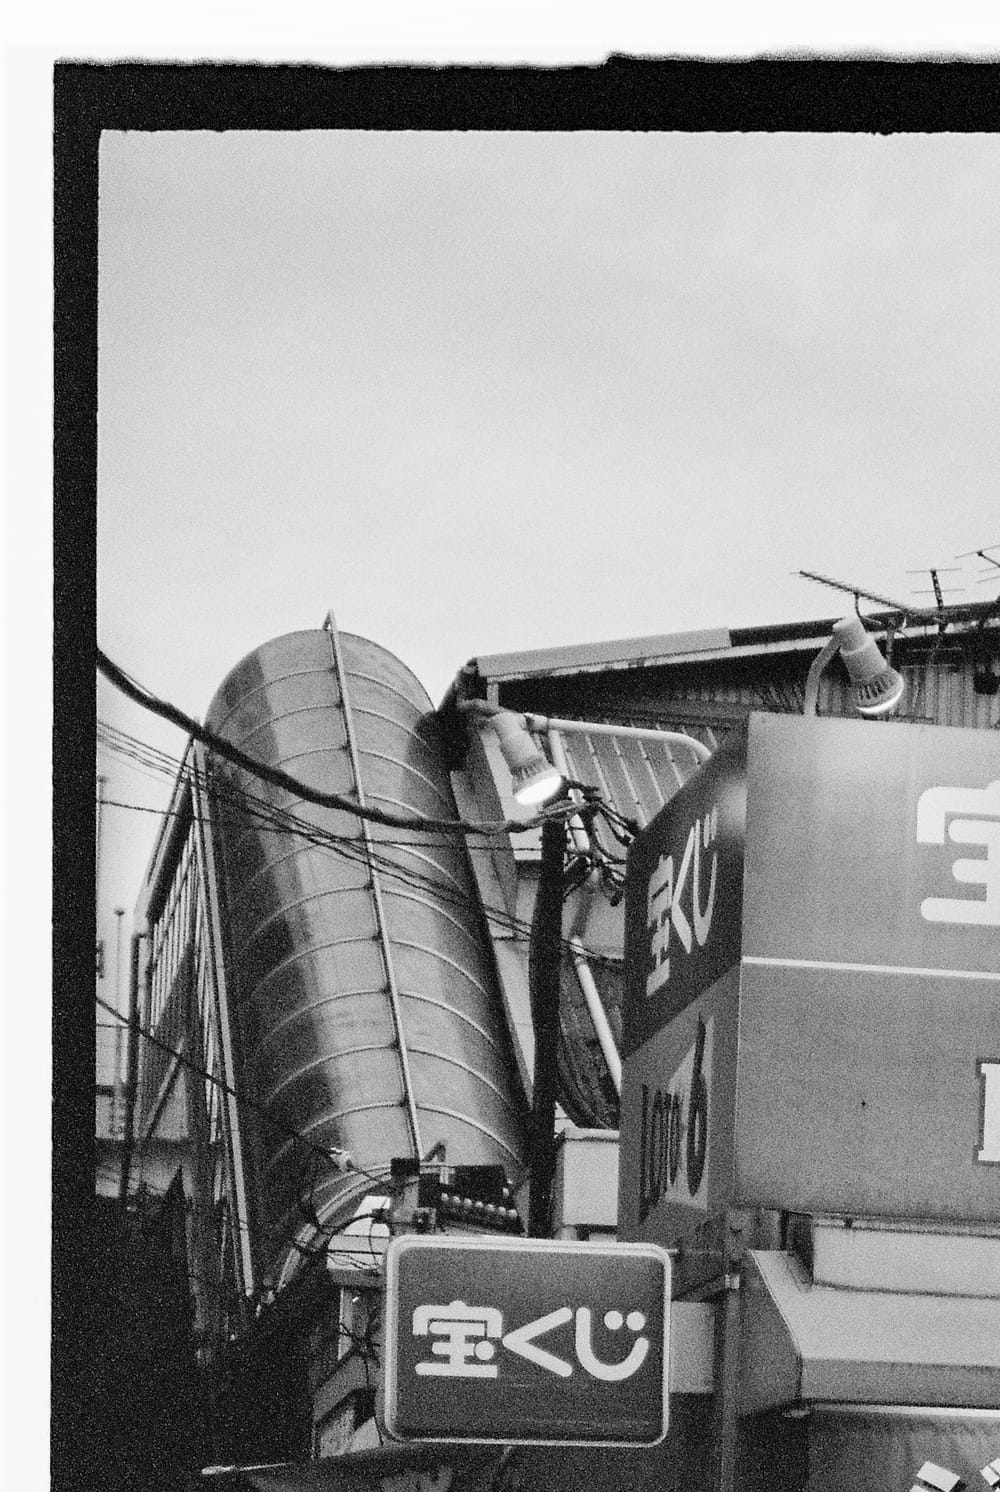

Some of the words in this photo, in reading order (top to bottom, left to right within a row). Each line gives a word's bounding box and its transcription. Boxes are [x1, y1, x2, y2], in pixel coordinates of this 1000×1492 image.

[645, 804, 719, 998] 宝くじ
[411, 1299, 650, 1382] 宝くじ
